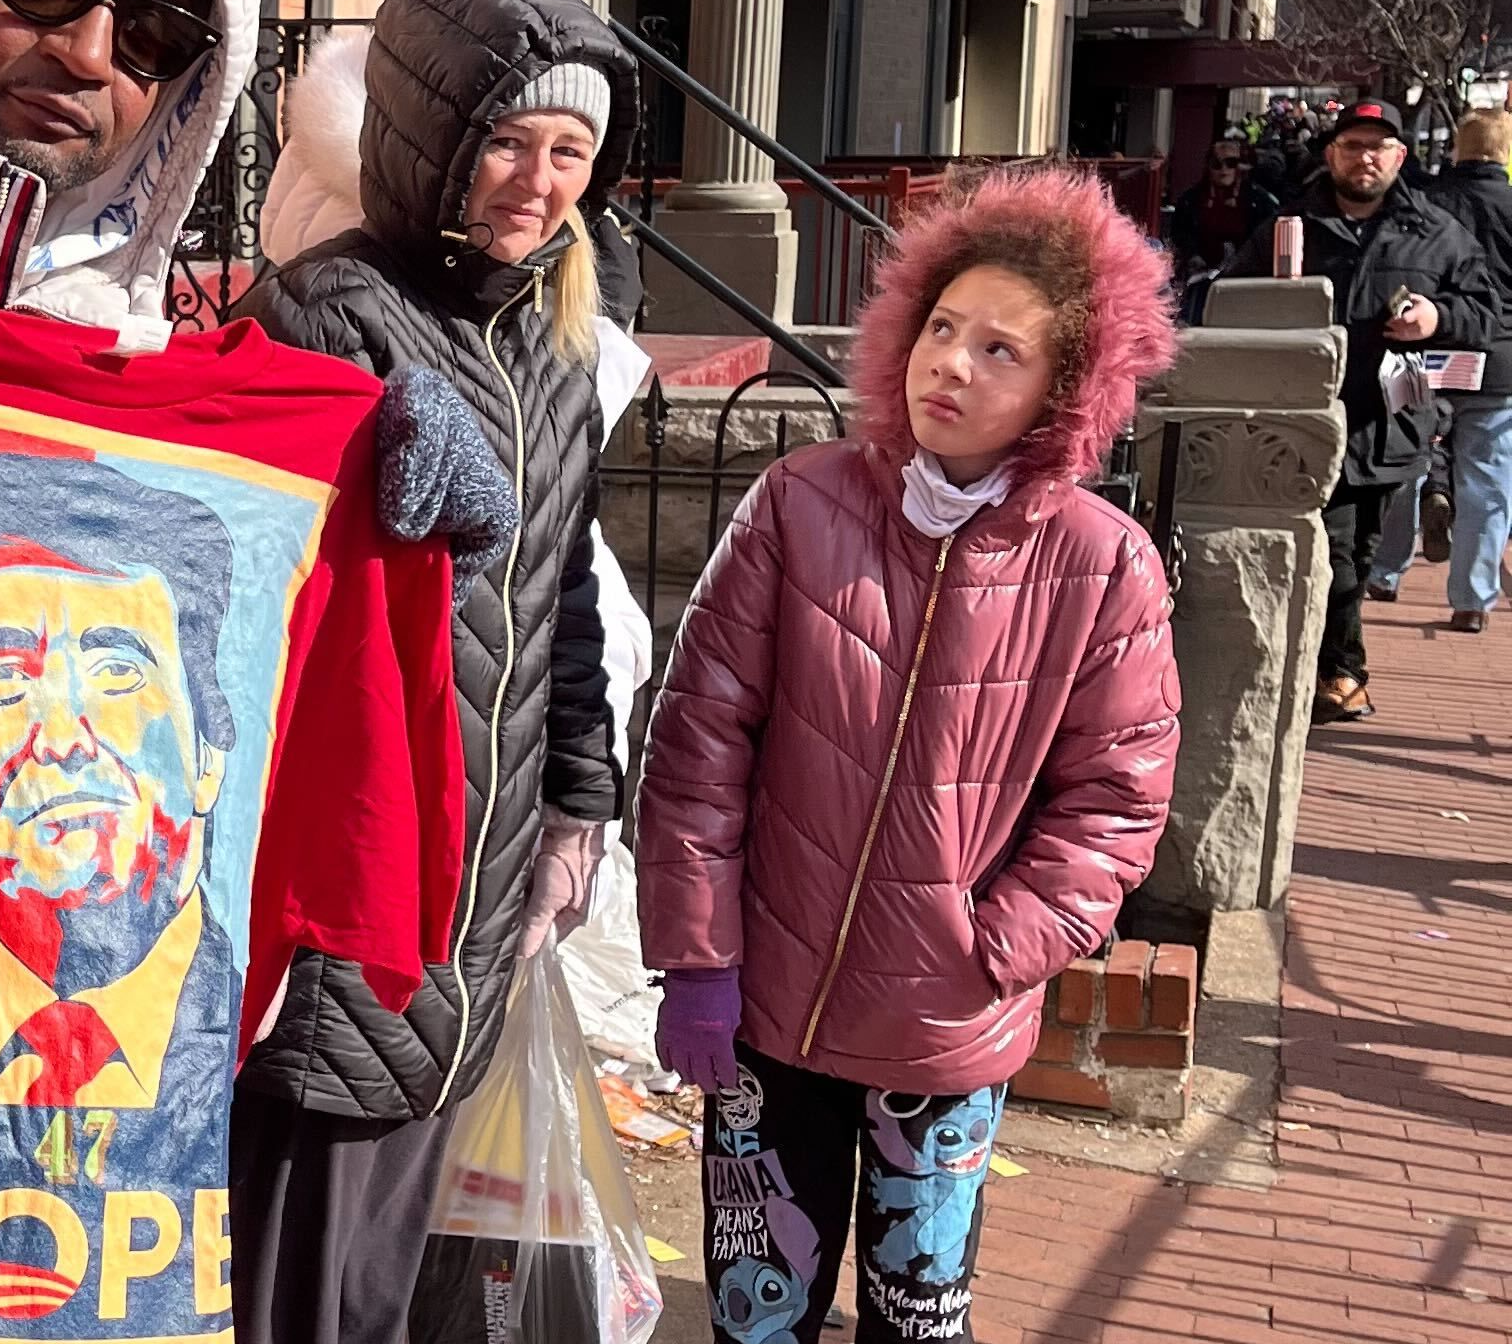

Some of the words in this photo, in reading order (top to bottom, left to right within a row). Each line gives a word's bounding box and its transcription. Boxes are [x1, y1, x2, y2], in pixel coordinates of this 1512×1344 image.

[34, 1110, 118, 1185] 47
[713, 1207, 764, 1236] MEANS
[711, 1229, 769, 1261] FAMILY
